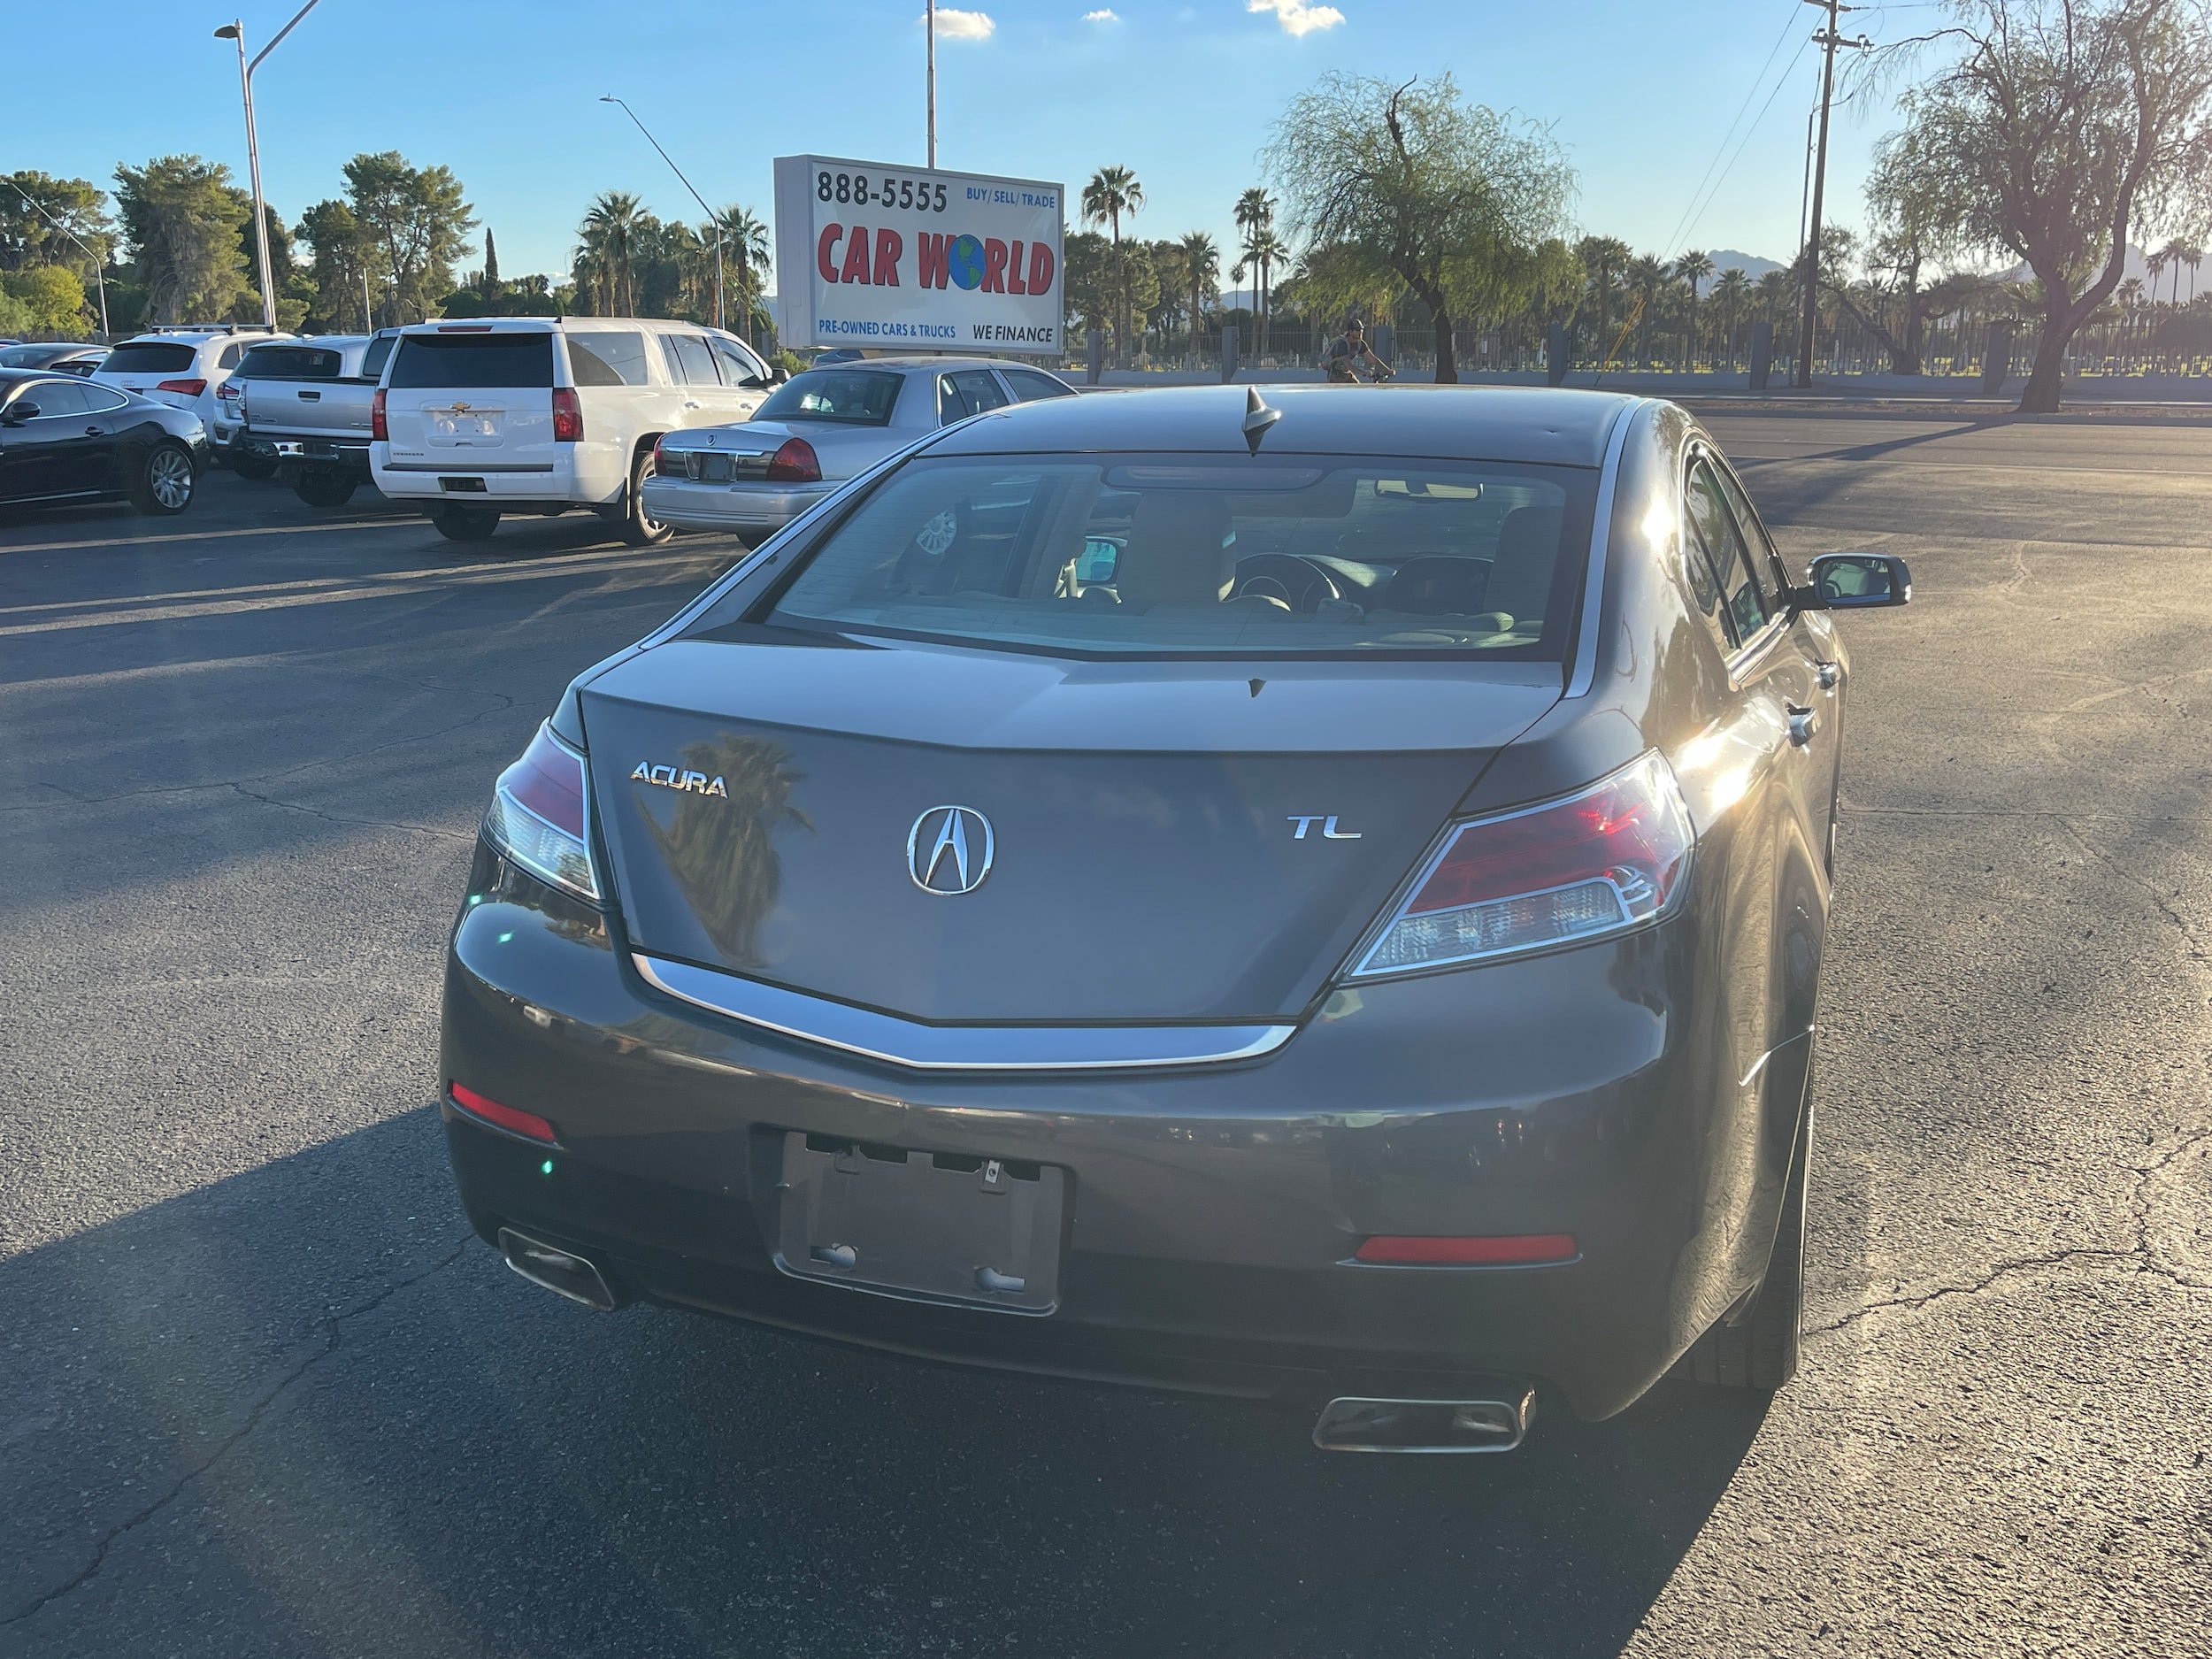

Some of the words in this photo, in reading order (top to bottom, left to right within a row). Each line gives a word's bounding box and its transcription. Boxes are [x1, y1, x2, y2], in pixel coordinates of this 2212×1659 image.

[818, 172, 948, 212] 888-5555
[1022, 193, 1055, 209] TRADE
[818, 223, 902, 287] CAR
[918, 232, 1055, 296] WORLD
[818, 319, 879, 335] PRE-OWNED
[881, 323, 908, 337] CARS
[910, 325, 918, 337] &
[918, 324, 956, 339] TRUCKS
[972, 324, 992, 340] WE
[995, 326, 1053, 342] FINANCE
[630, 760, 728, 799] ACURA
[1286, 815, 1363, 840] TL
